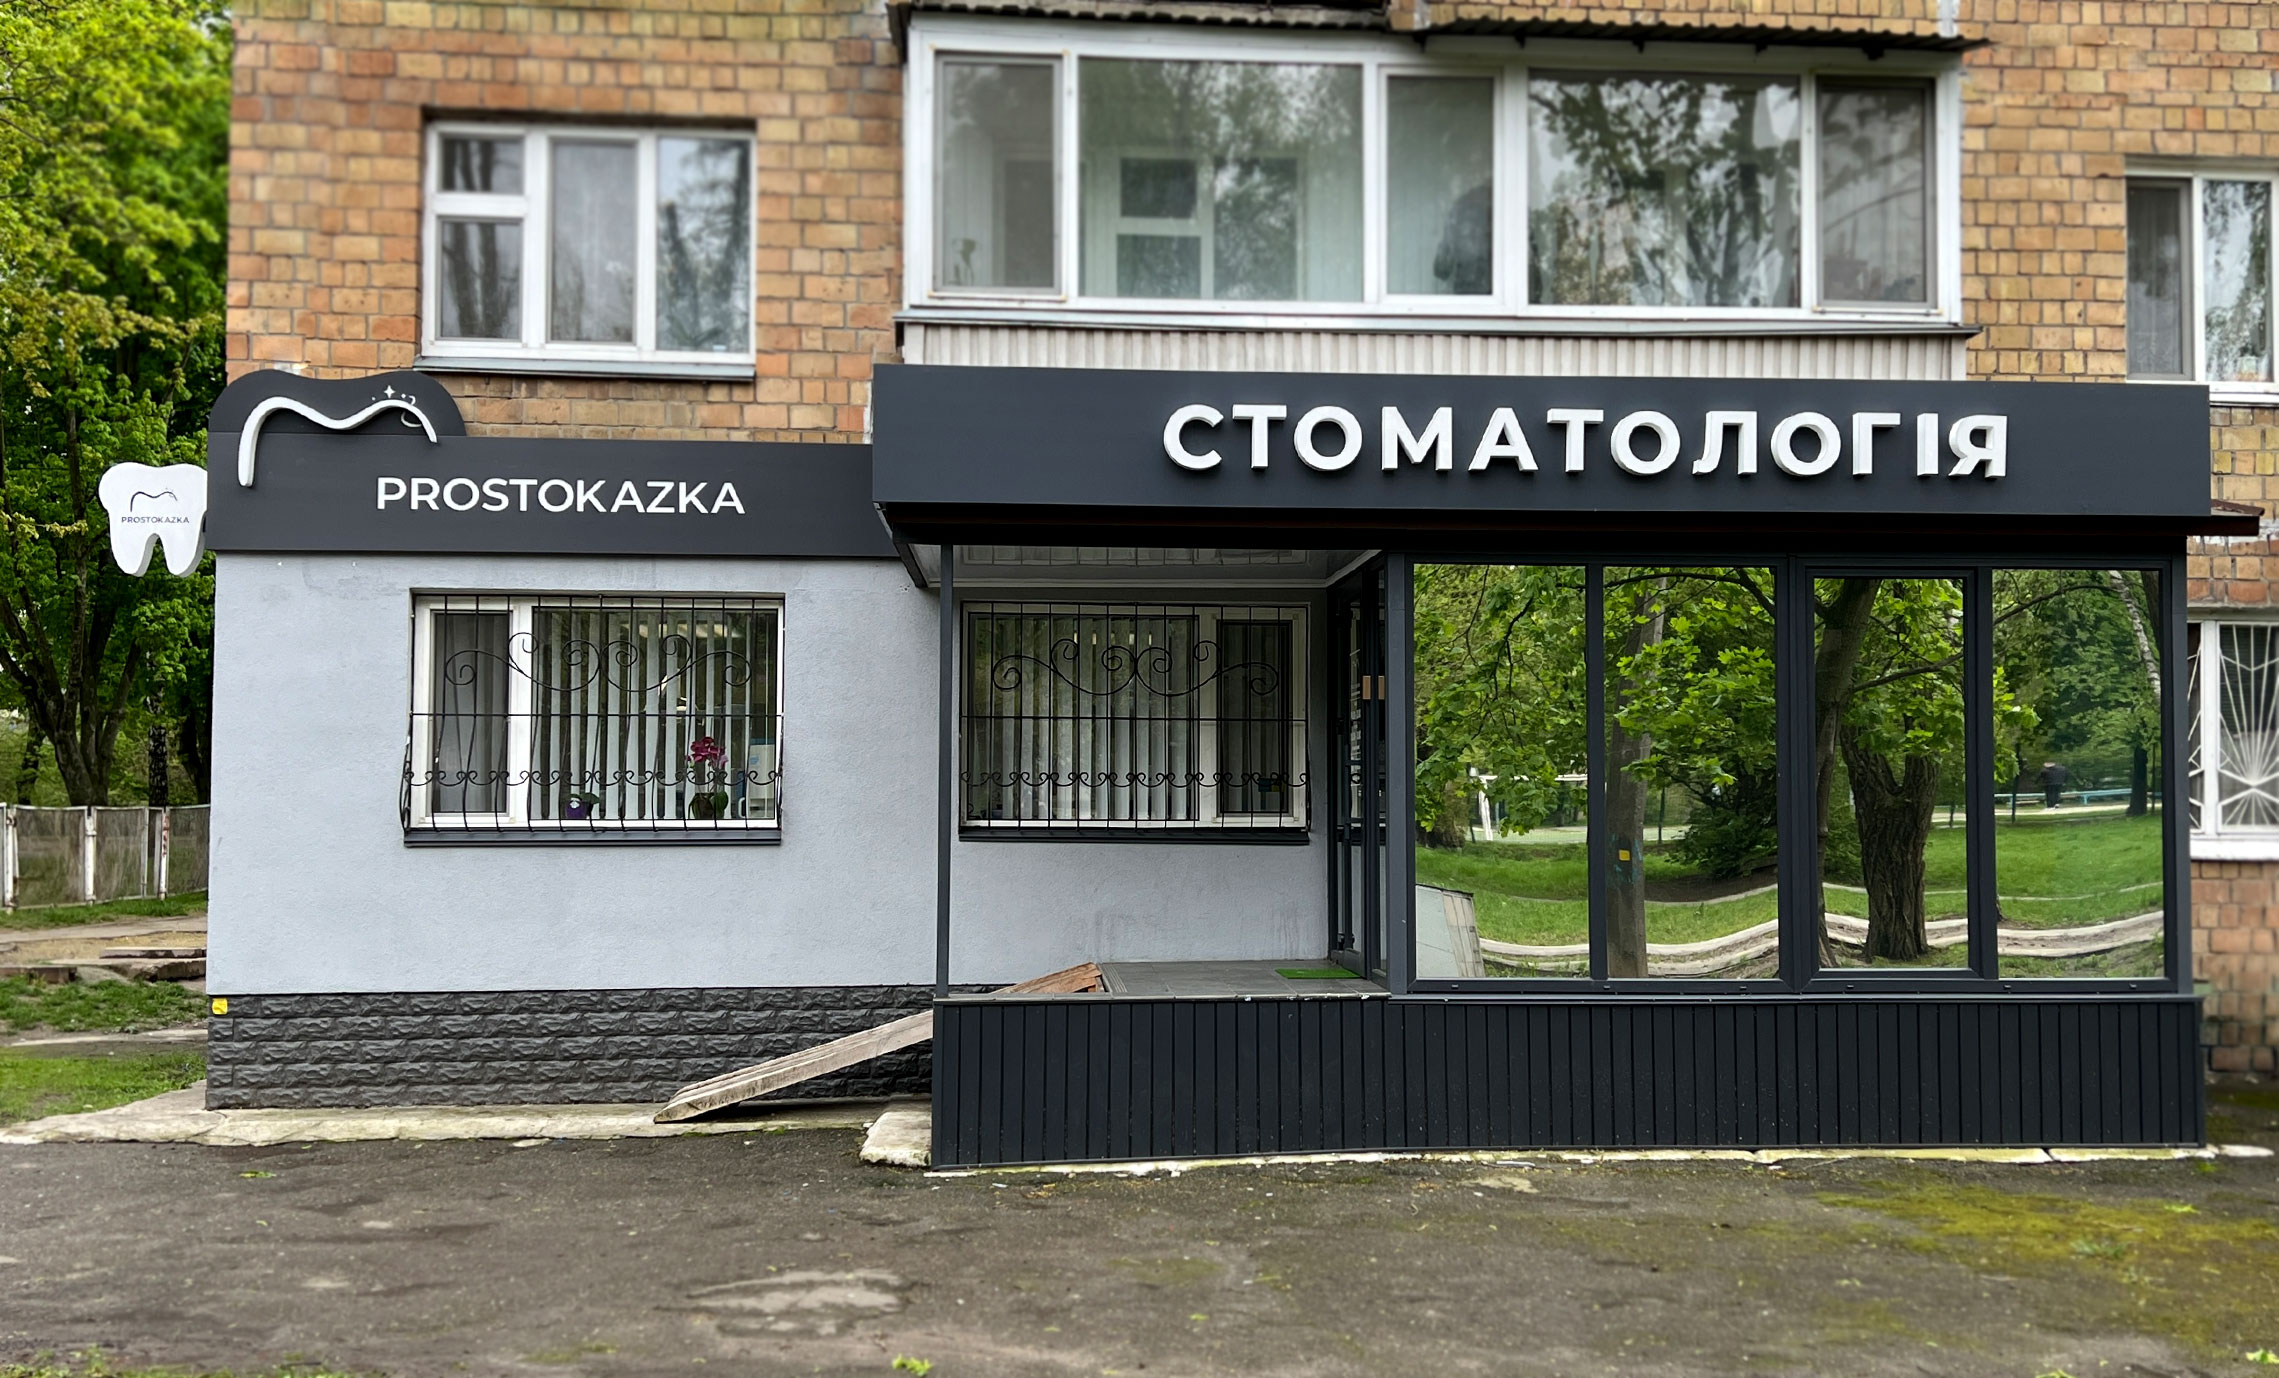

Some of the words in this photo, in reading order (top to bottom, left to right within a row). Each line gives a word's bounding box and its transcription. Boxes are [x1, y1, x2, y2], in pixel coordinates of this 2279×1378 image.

[1162, 402, 2009, 479] СТОМАТОЛОГІЯ
[376, 477, 746, 515] PROSTOKAZKA
[121, 516, 190, 524] PROSTOKAZKA
